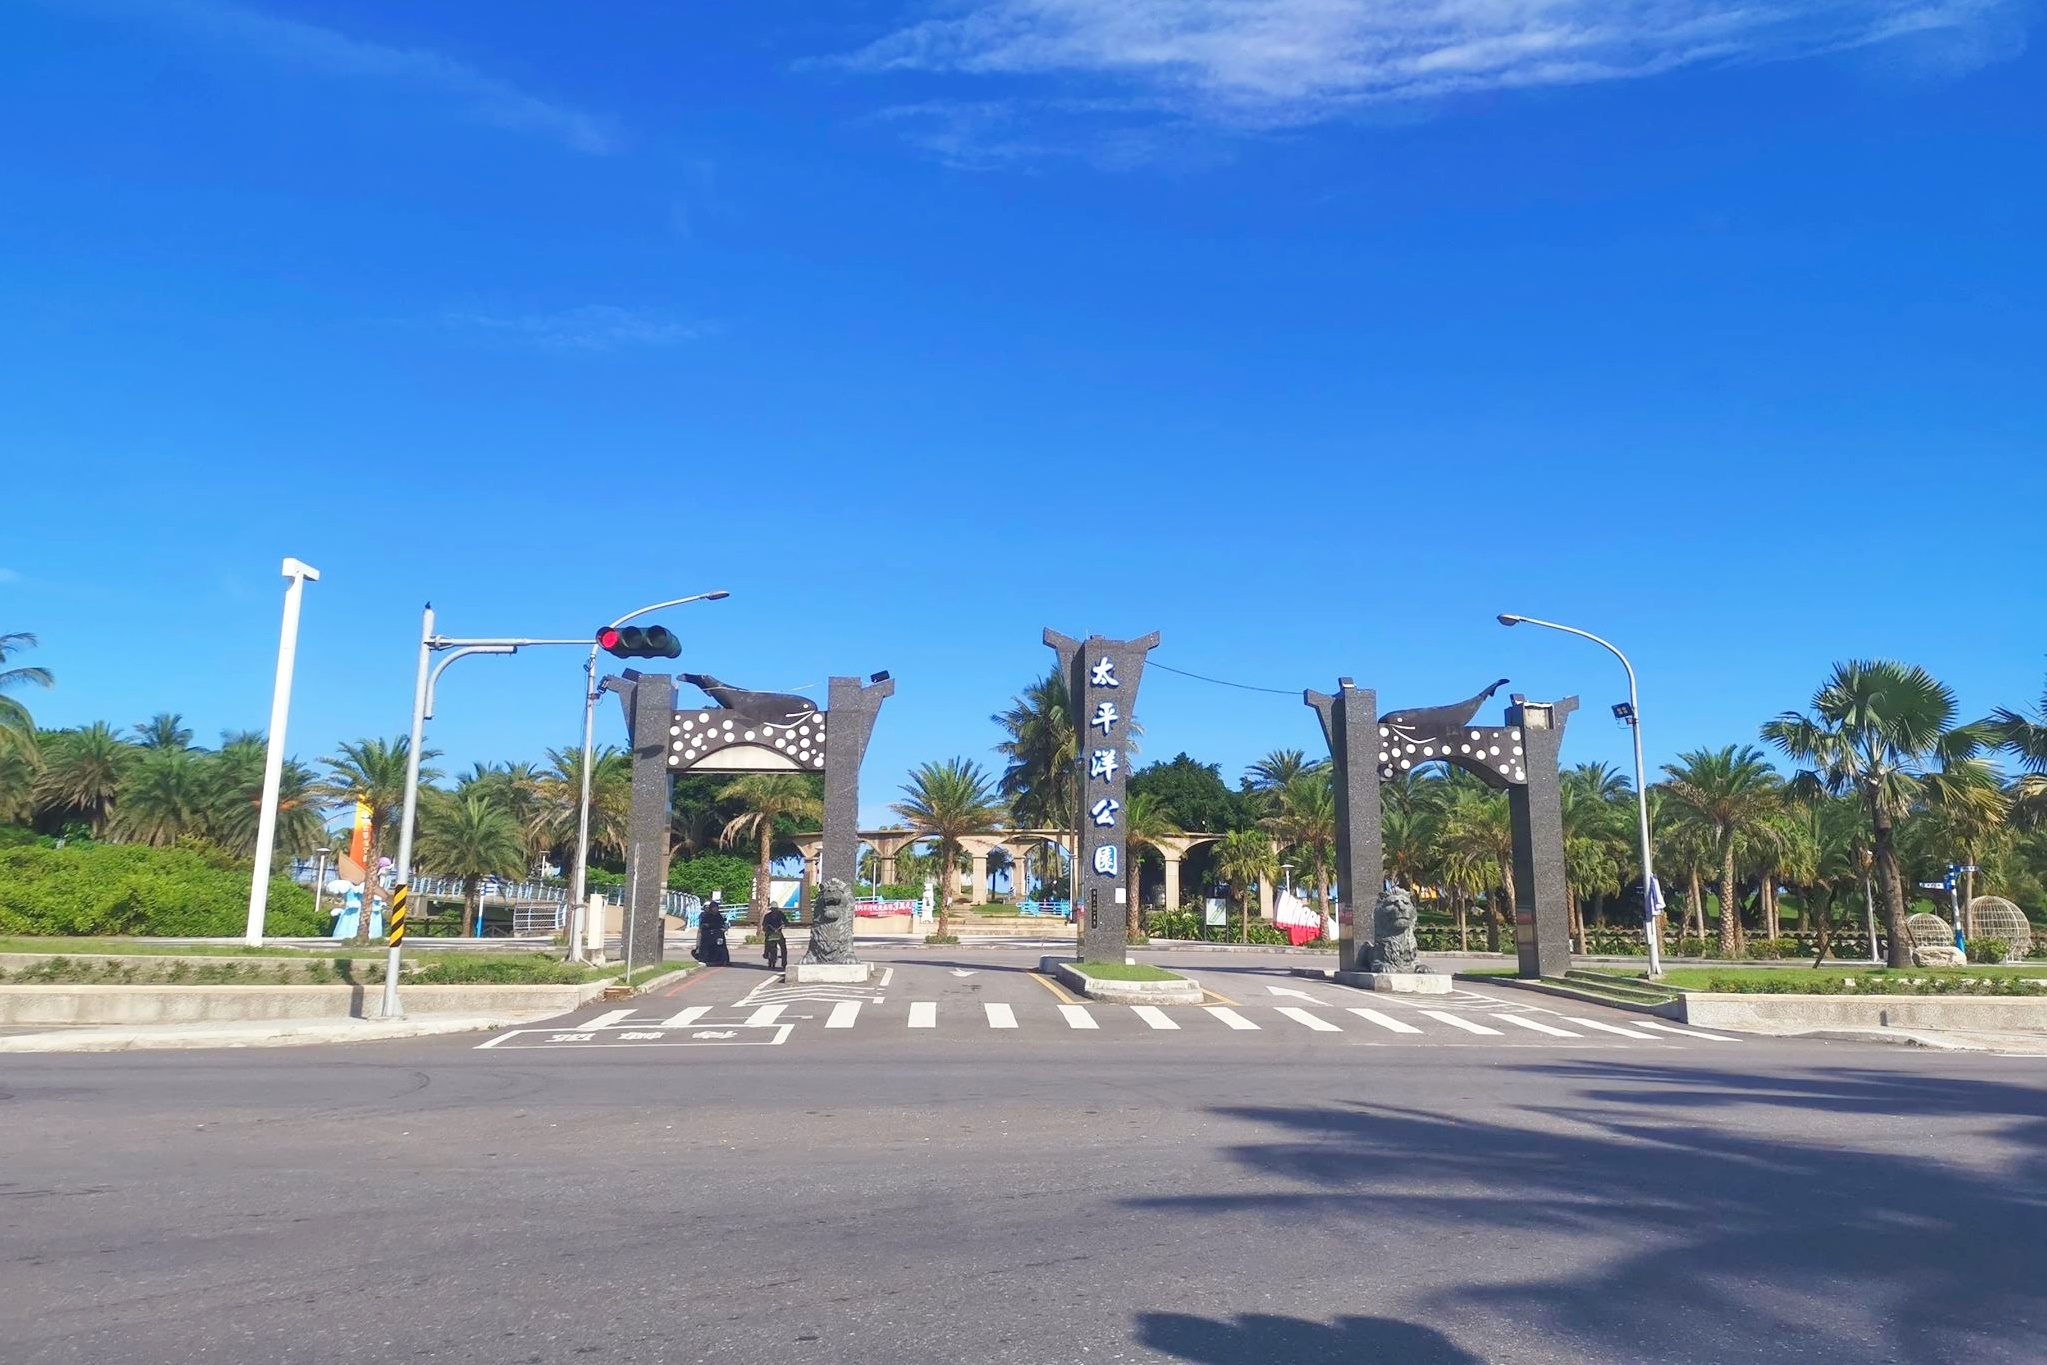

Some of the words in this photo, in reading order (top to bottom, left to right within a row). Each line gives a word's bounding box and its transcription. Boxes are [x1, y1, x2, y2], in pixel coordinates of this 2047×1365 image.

[1091, 656, 1119, 876] 太平洋公園
